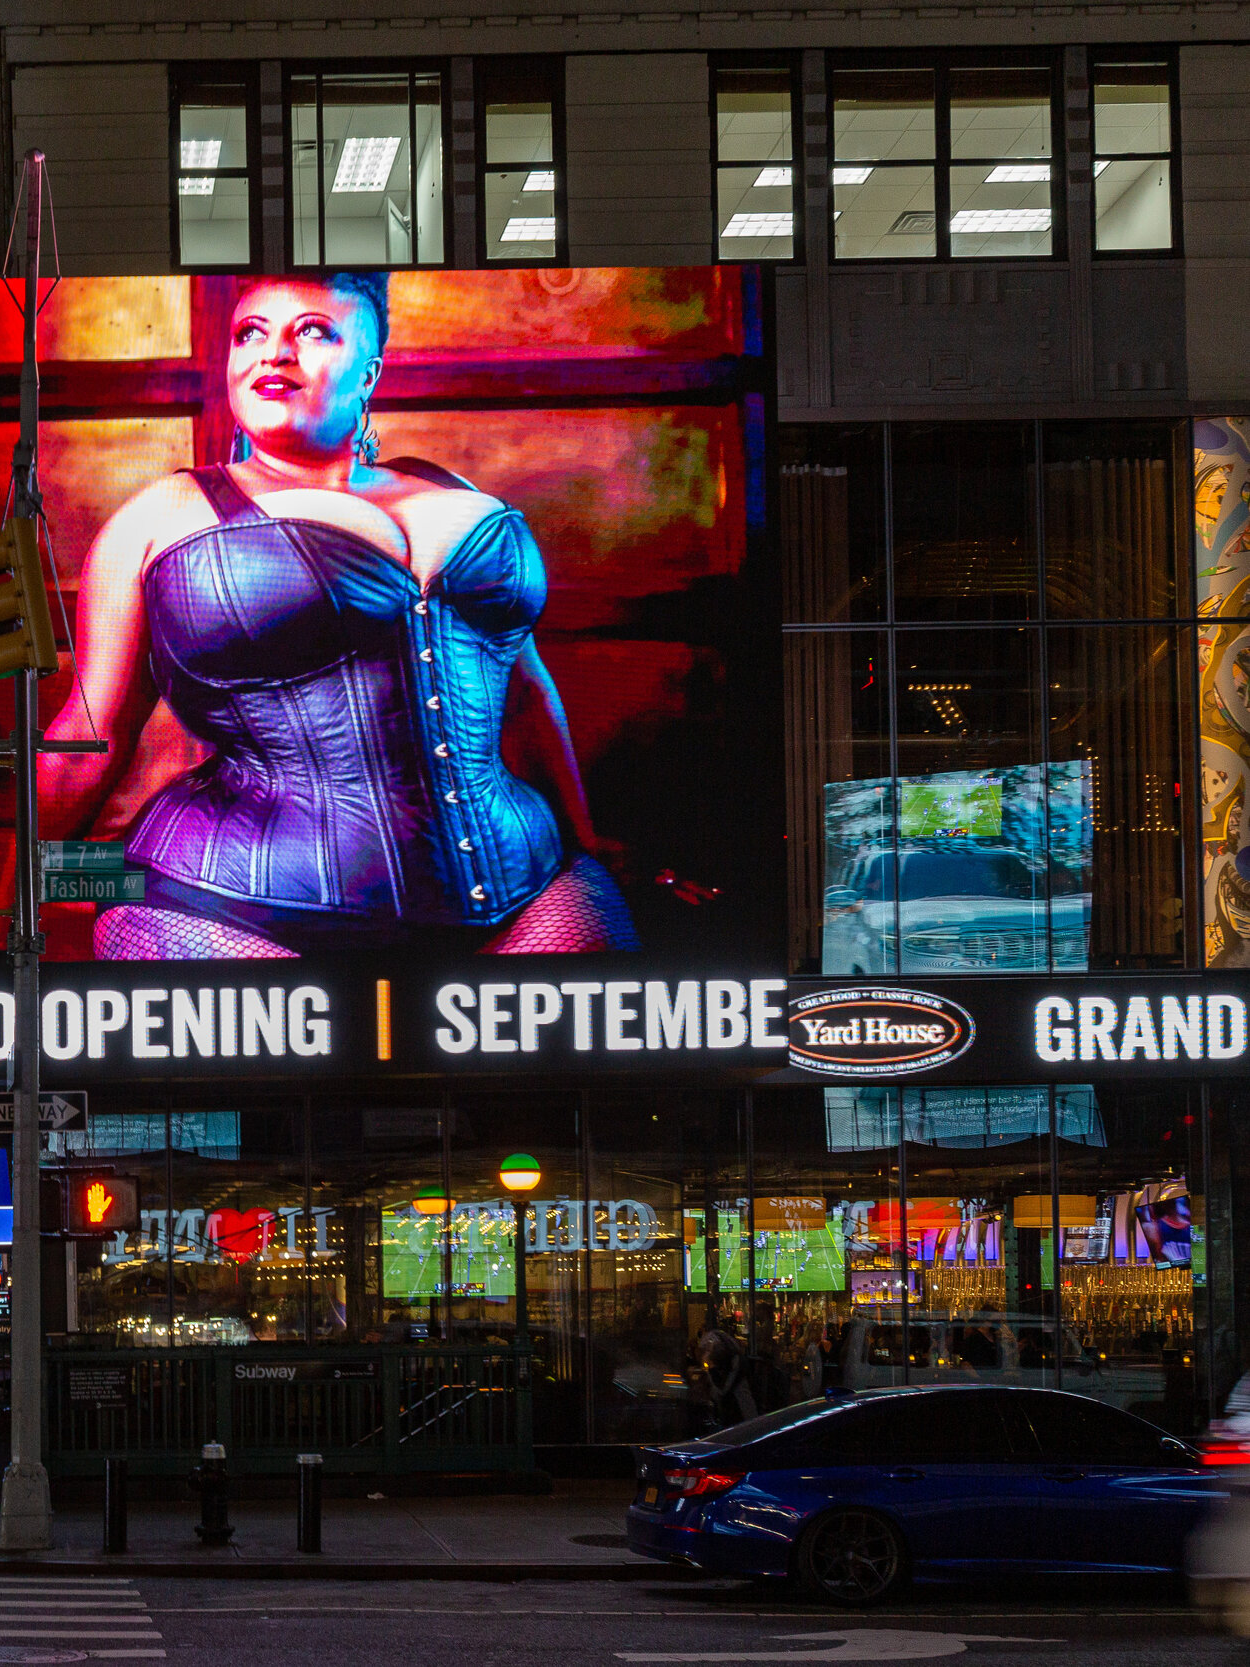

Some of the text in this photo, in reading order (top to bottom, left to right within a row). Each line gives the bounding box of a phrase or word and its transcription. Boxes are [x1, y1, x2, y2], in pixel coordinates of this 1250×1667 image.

[77, 845, 87, 867] 7
[94, 846, 108, 859] Av
[50, 875, 137, 898] Fashion Av
[41, 985, 332, 1060] OPENING
[434, 978, 790, 1054] SEPTEMBE
[800, 1016, 946, 1046] Yard House
[1033, 994, 1249, 1063] GRAND
[234, 1363, 297, 1381] Subway
